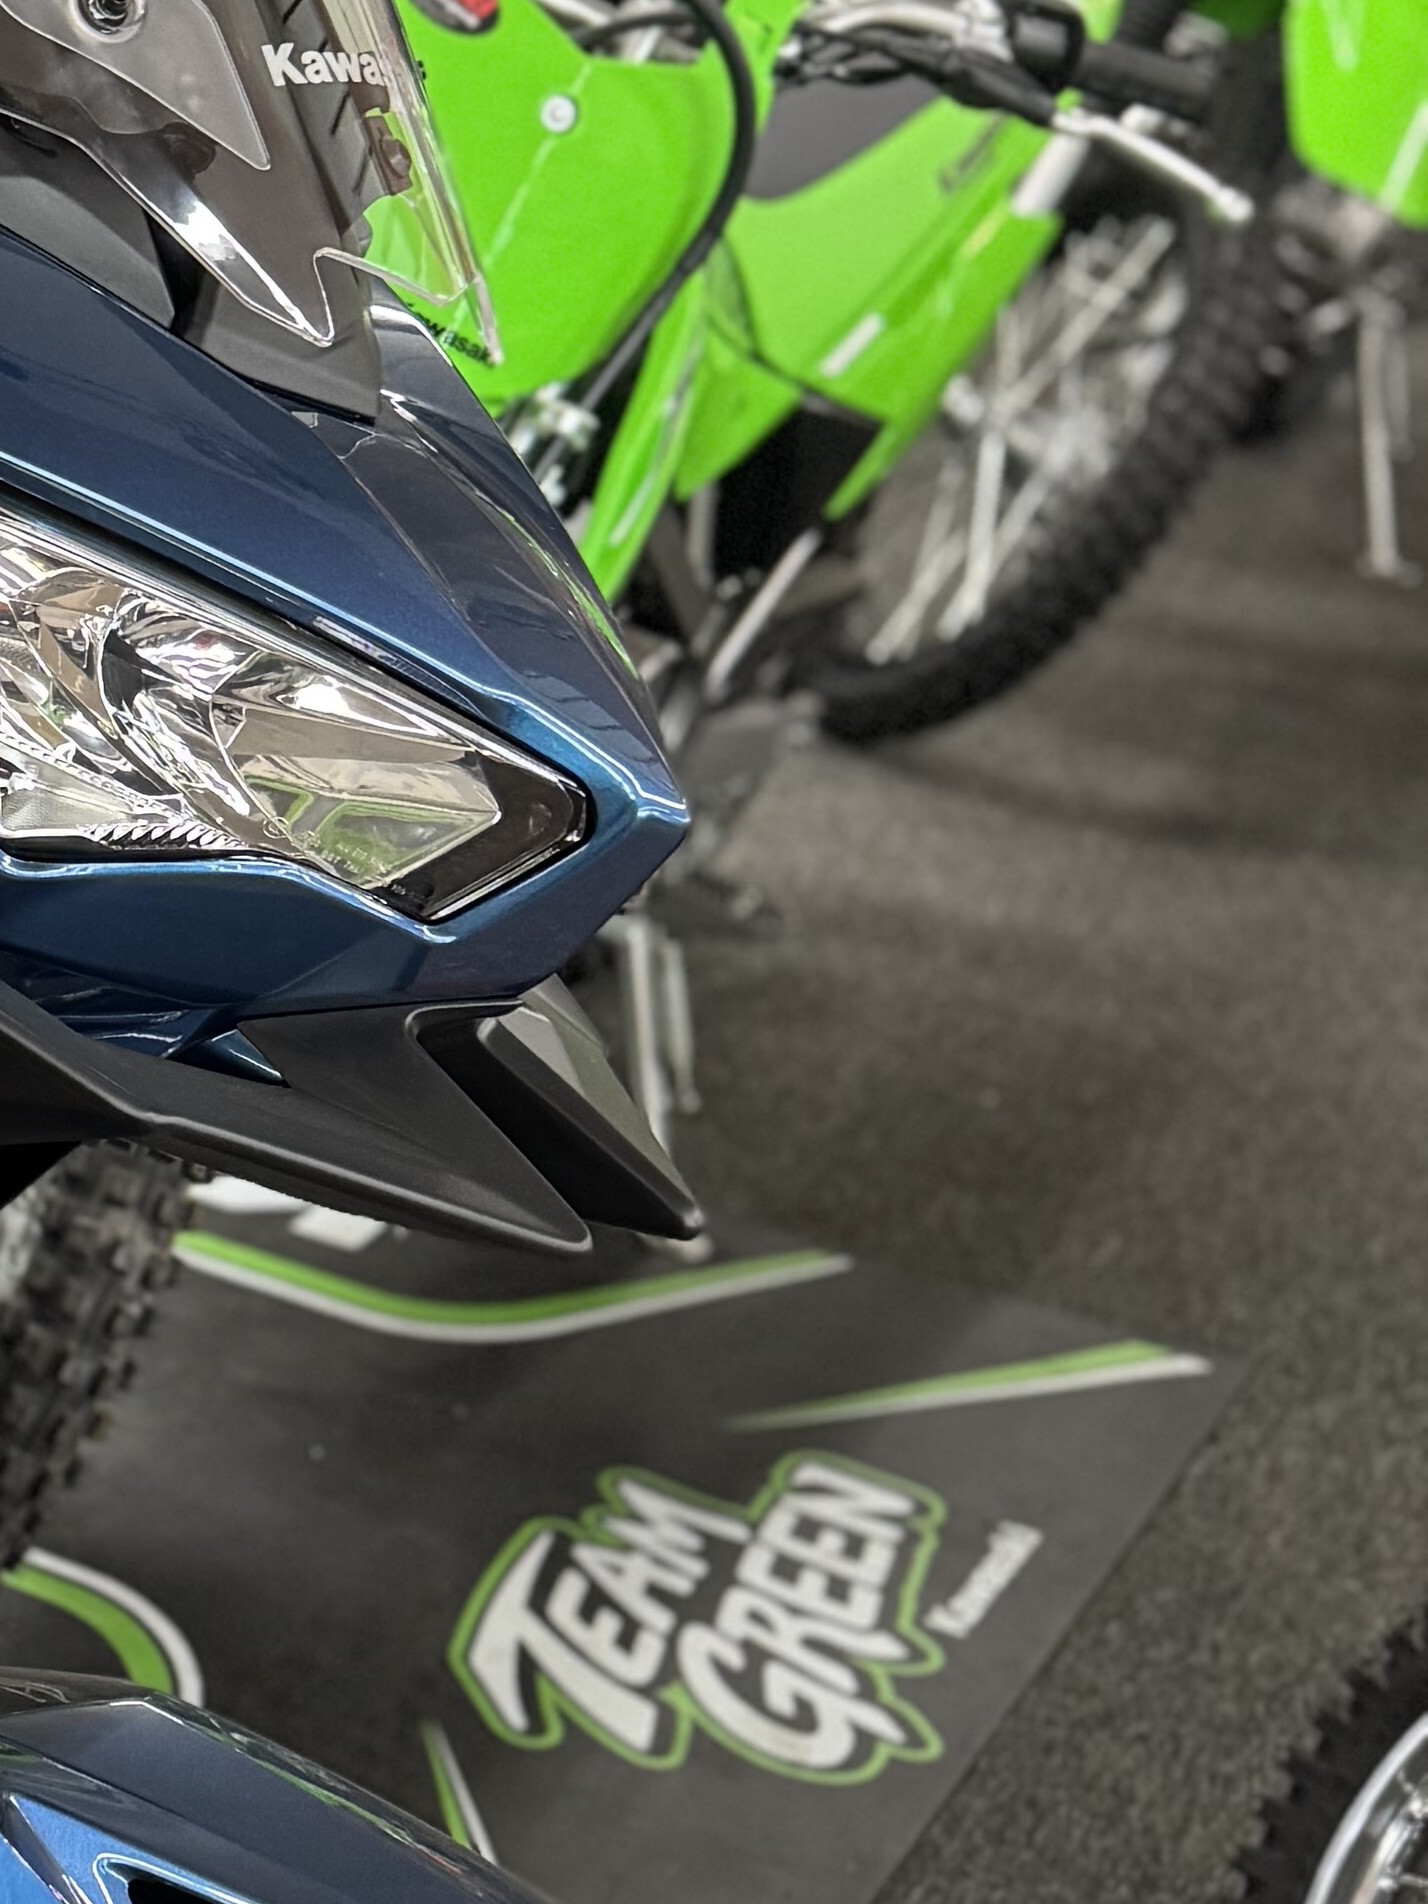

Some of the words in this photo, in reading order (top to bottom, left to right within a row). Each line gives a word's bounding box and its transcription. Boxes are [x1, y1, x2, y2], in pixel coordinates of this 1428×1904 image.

[260, 42, 394, 87] Kawa
[468, 1478, 750, 1754] TEAM
[676, 1460, 915, 1768] GREEN
